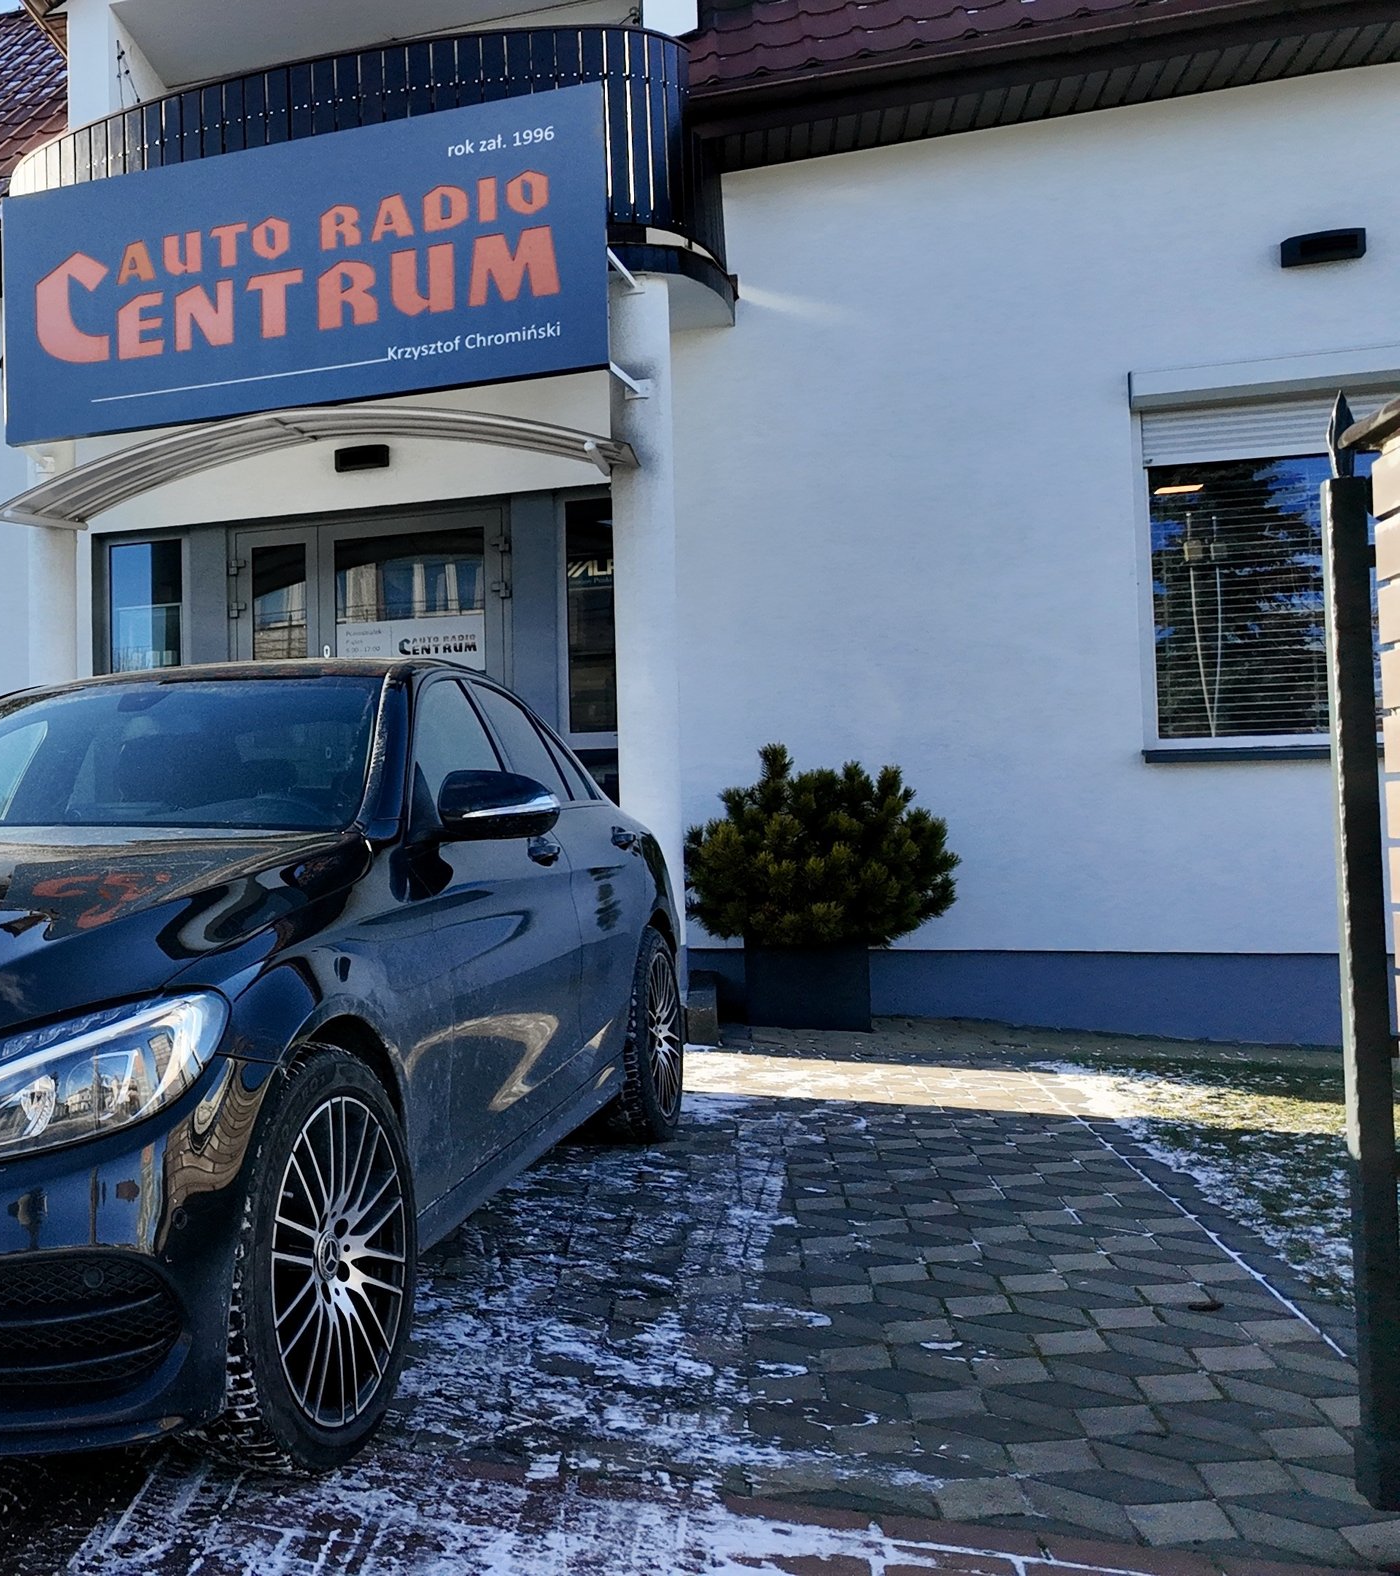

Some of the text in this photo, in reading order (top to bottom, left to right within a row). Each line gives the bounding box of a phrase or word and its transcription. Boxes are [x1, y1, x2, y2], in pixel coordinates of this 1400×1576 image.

[447, 125, 555, 157] rok zał. 1996
[117, 169, 549, 286] AUTO RADIO
[35, 224, 562, 364] CENTRUM
[387, 321, 561, 362] Krzysztof Chromiński
[398, 638, 478, 656] CENTRUM
[412, 633, 477, 645] AUTO RADIO
